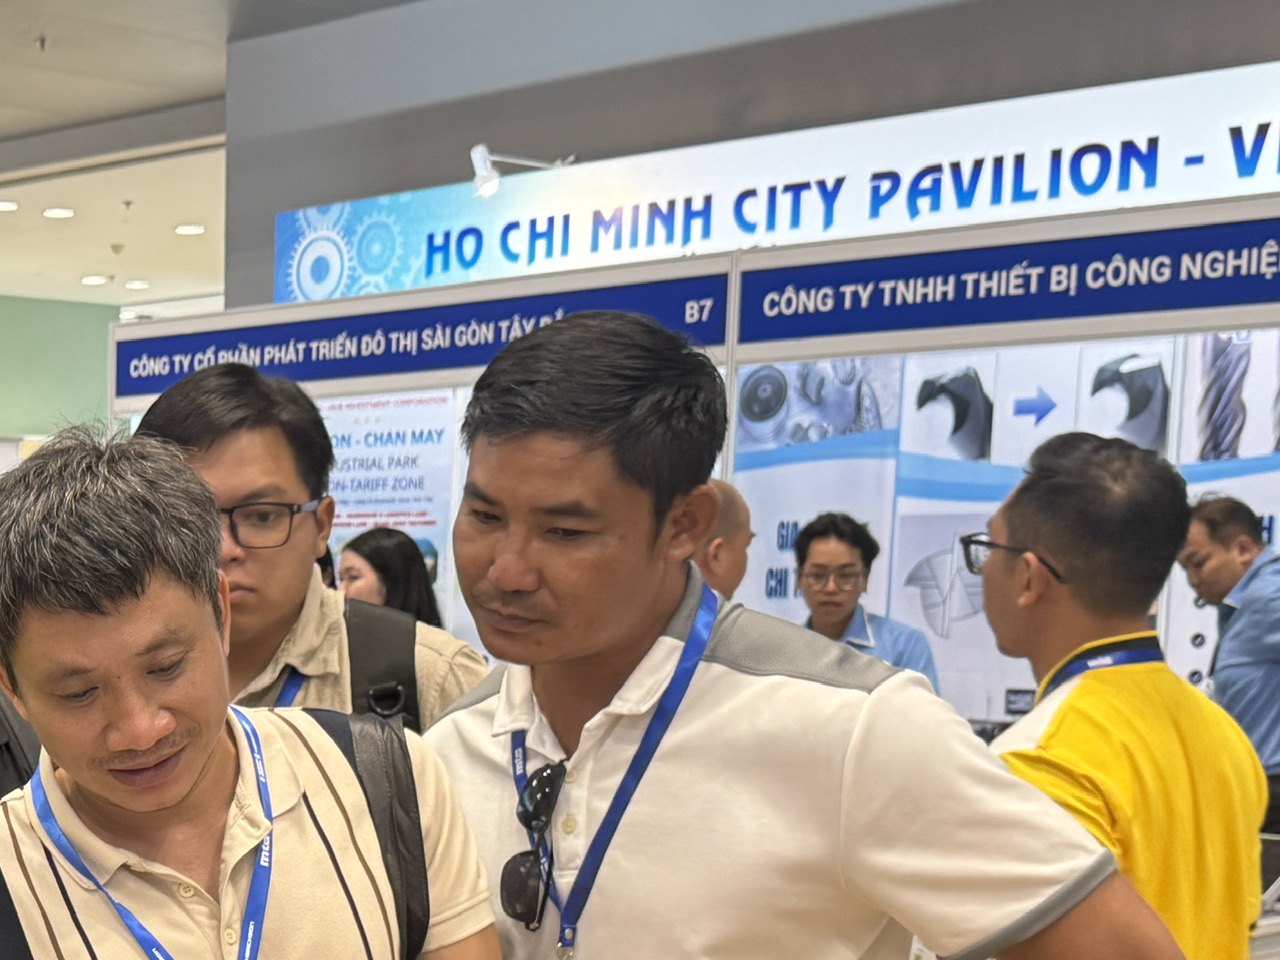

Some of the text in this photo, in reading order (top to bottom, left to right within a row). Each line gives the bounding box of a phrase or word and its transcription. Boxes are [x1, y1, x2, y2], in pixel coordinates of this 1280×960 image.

[424, 226, 483, 279] HO
[500, 213, 571, 267] CHI
[591, 194, 713, 259] MINH
[733, 176, 846, 234] CITY
[868, 135, 1160, 221] PAVILION
[763, 238, 1280, 318] CÔNG TY TNHH THIẾT BỊ CÔNG NGHIỆ
[685, 298, 714, 325] B7
[129, 353, 170, 379] CÔNG
[173, 352, 193, 374] TY
[263, 337, 306, 366] PHÁT
[388, 328, 419, 356] THỊ
[421, 322, 452, 351] SÀI
[454, 318, 495, 347] GÒN
[364, 431, 406, 447] CHAN
[410, 428, 445, 445] MAY
[335, 455, 420, 472] USTRIAL PARK
[391, 476, 425, 492] ZONE
[765, 568, 789, 599] CHI
